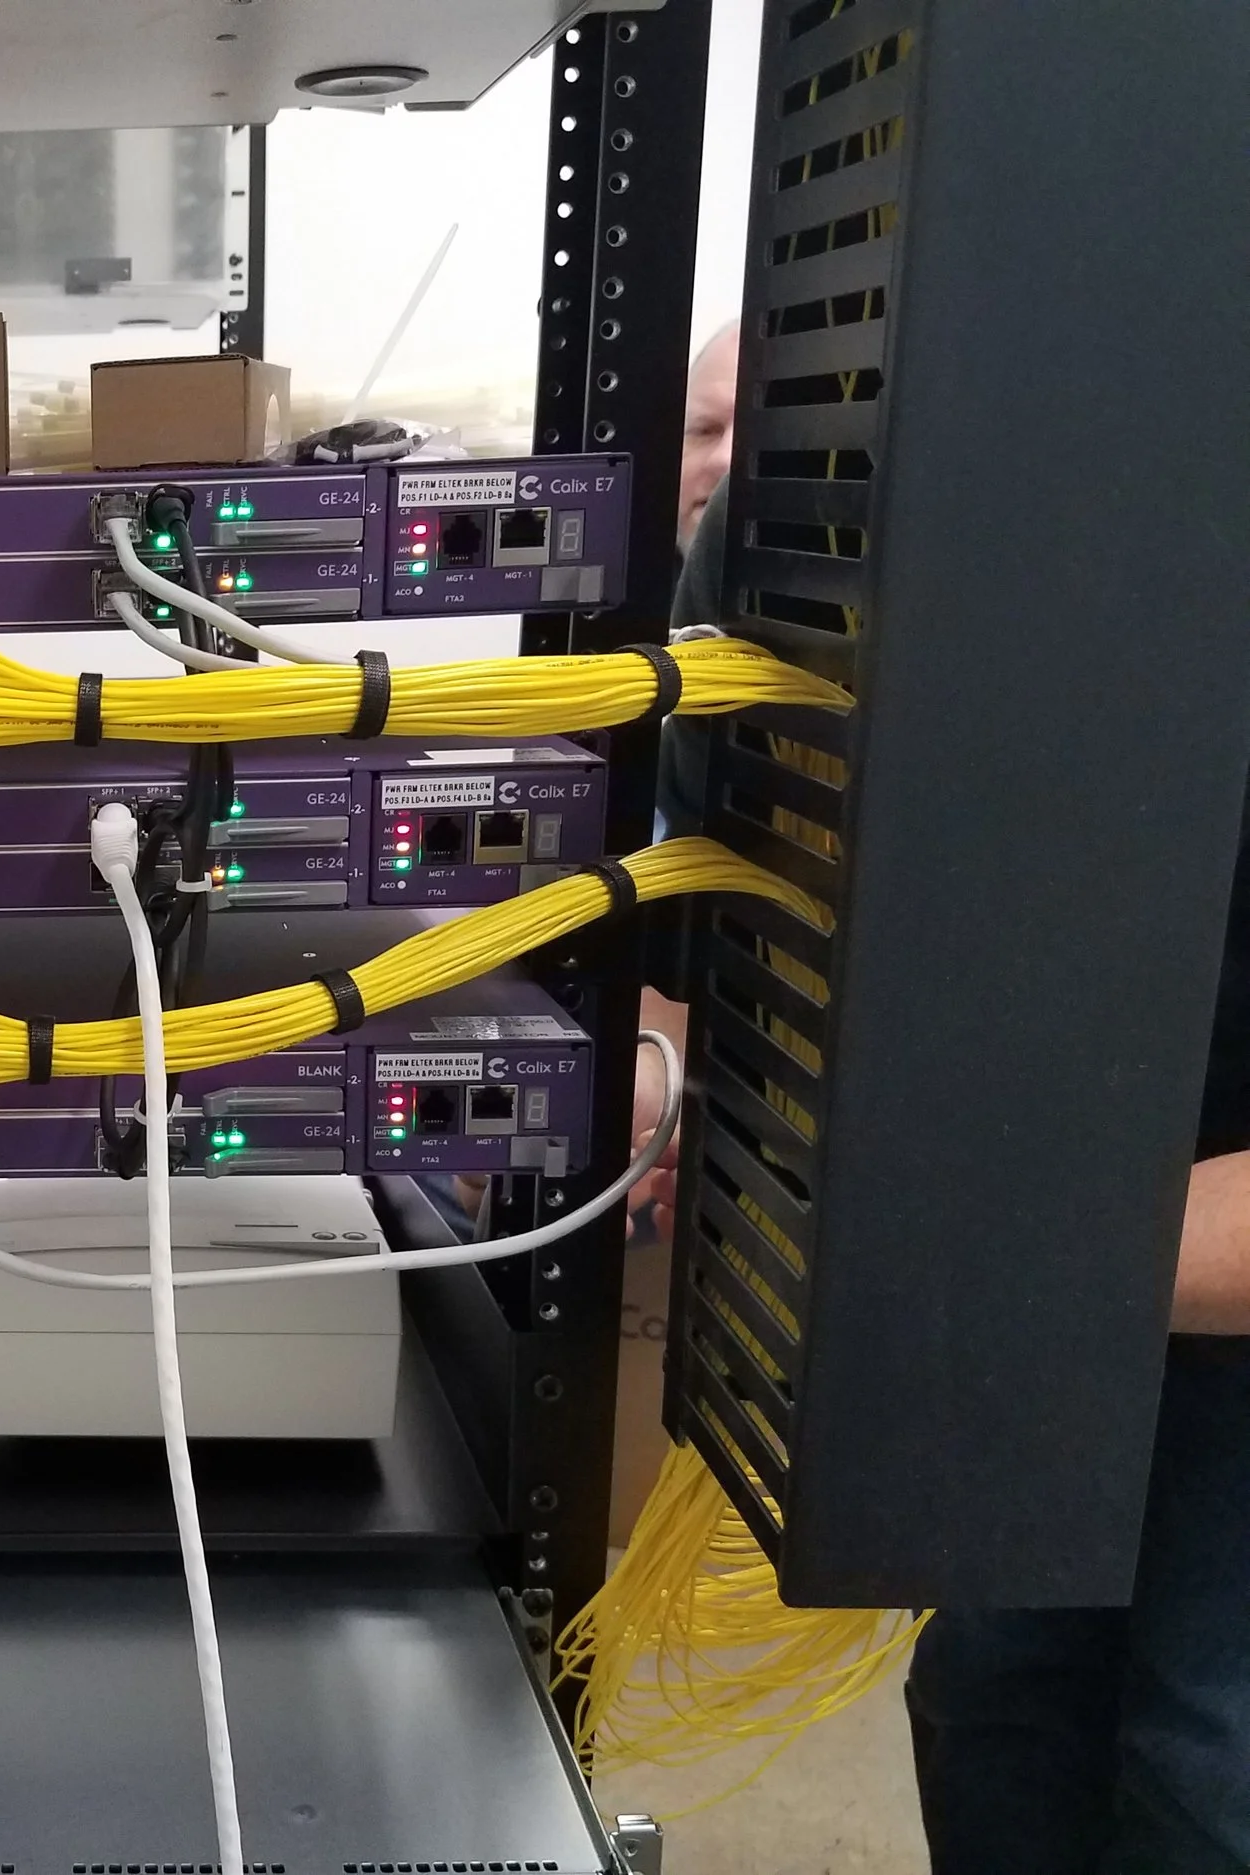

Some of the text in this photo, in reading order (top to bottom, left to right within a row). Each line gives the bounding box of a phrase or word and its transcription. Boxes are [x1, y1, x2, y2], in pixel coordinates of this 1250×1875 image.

[402, 478, 512, 489] PWR FRM ELTEK BRKR BELOW
[550, 477, 615, 494] Calix E7
[319, 491, 360, 505] GE-24
[429, 492, 448, 501] LD-A
[484, 491, 502, 500] LD-B
[317, 563, 358, 577] GE-24
[395, 588, 412, 596] ACO
[385, 782, 491, 793] PWR FRM ELTEK BRKR BELOW
[528, 783, 591, 799] Calix E7
[307, 792, 346, 805] GE-24
[411, 796, 429, 804] LD-A
[463, 794, 482, 802] LD-B
[305, 857, 344, 869] GE-24
[395, 1059, 409, 1067] FRM
[455, 1058, 479, 1066] BELOW
[516, 1060, 576, 1074] Calix E7
[298, 1065, 343, 1077] BLANK
[453, 1069, 470, 1077] LD-B
[303, 1126, 341, 1137] GE-24
